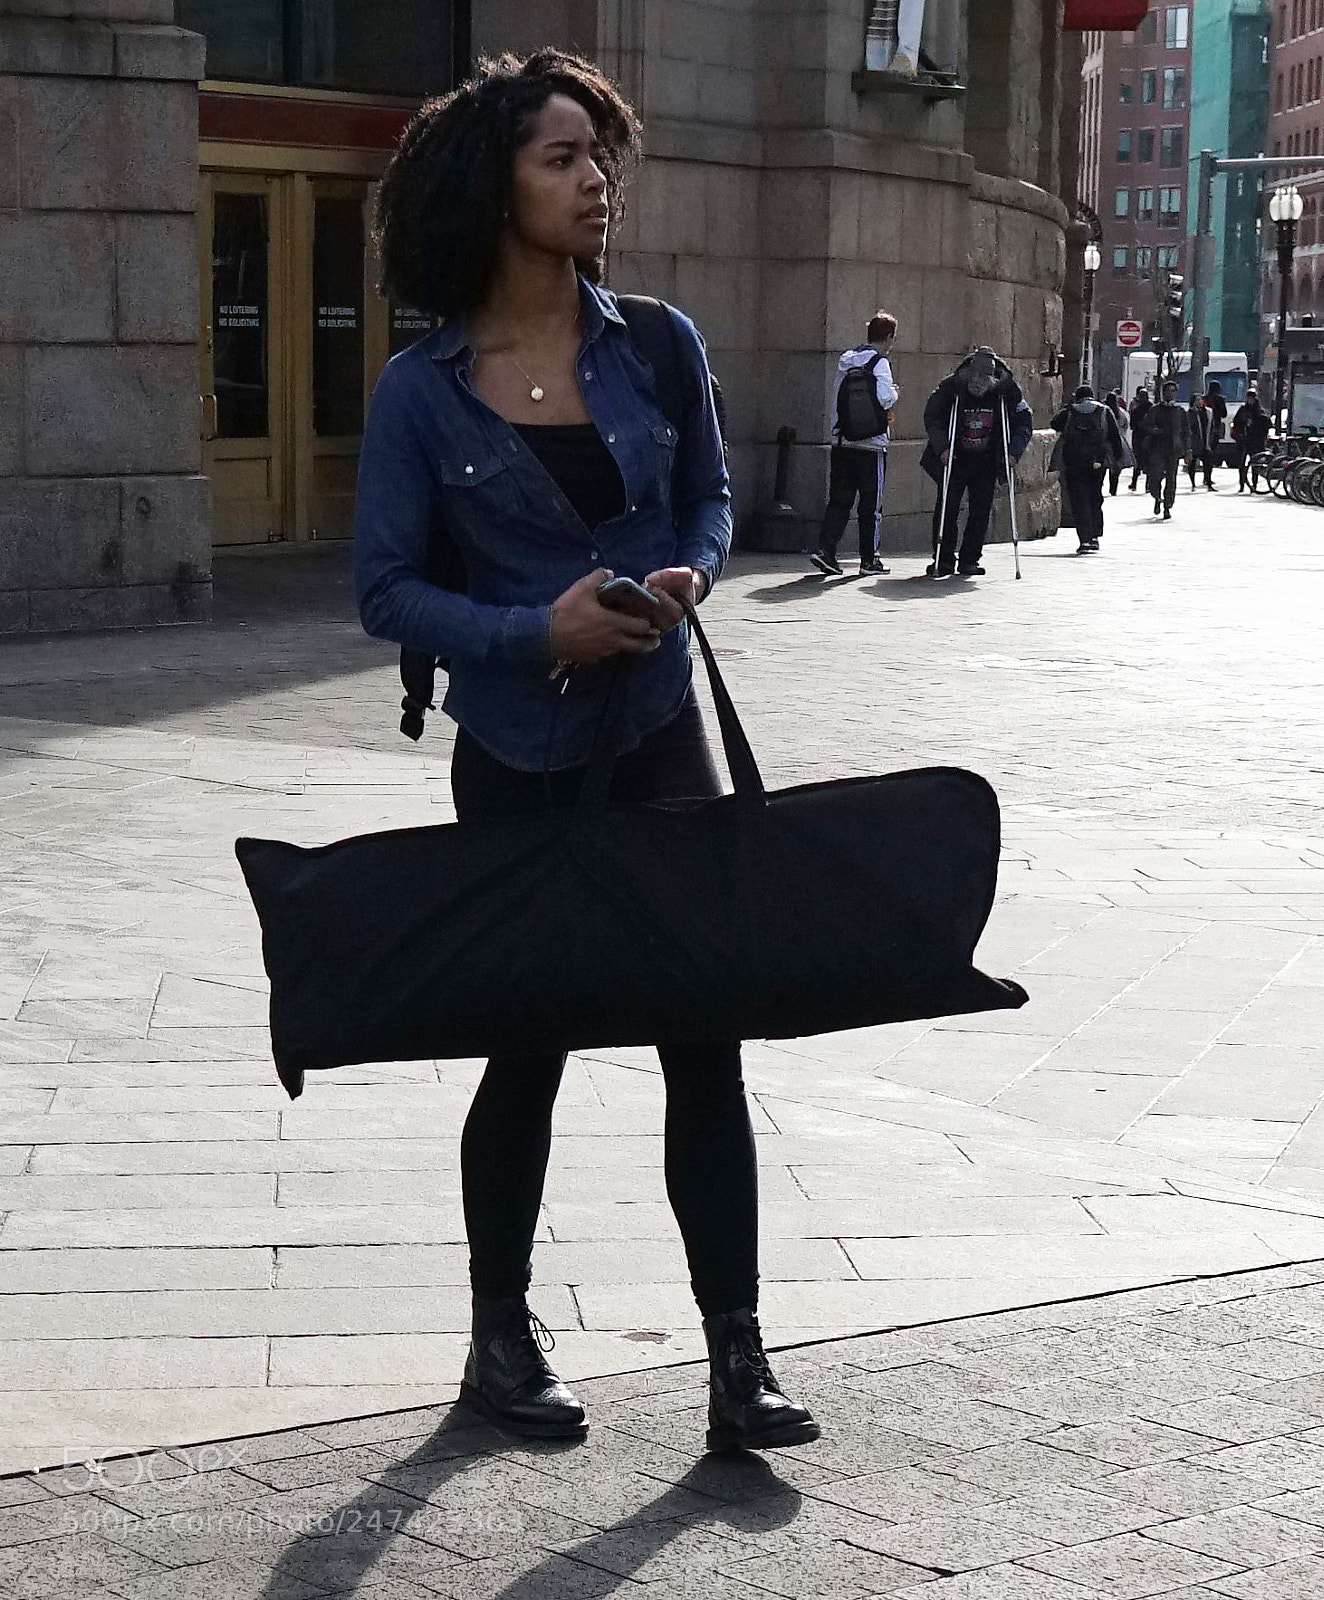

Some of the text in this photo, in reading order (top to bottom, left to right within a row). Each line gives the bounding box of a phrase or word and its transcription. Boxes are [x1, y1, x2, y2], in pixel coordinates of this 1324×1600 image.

[219, 305, 228, 314] NO
[318, 306, 327, 315] NO
[218, 318, 227, 326] NO
[318, 319, 326, 328] NO
